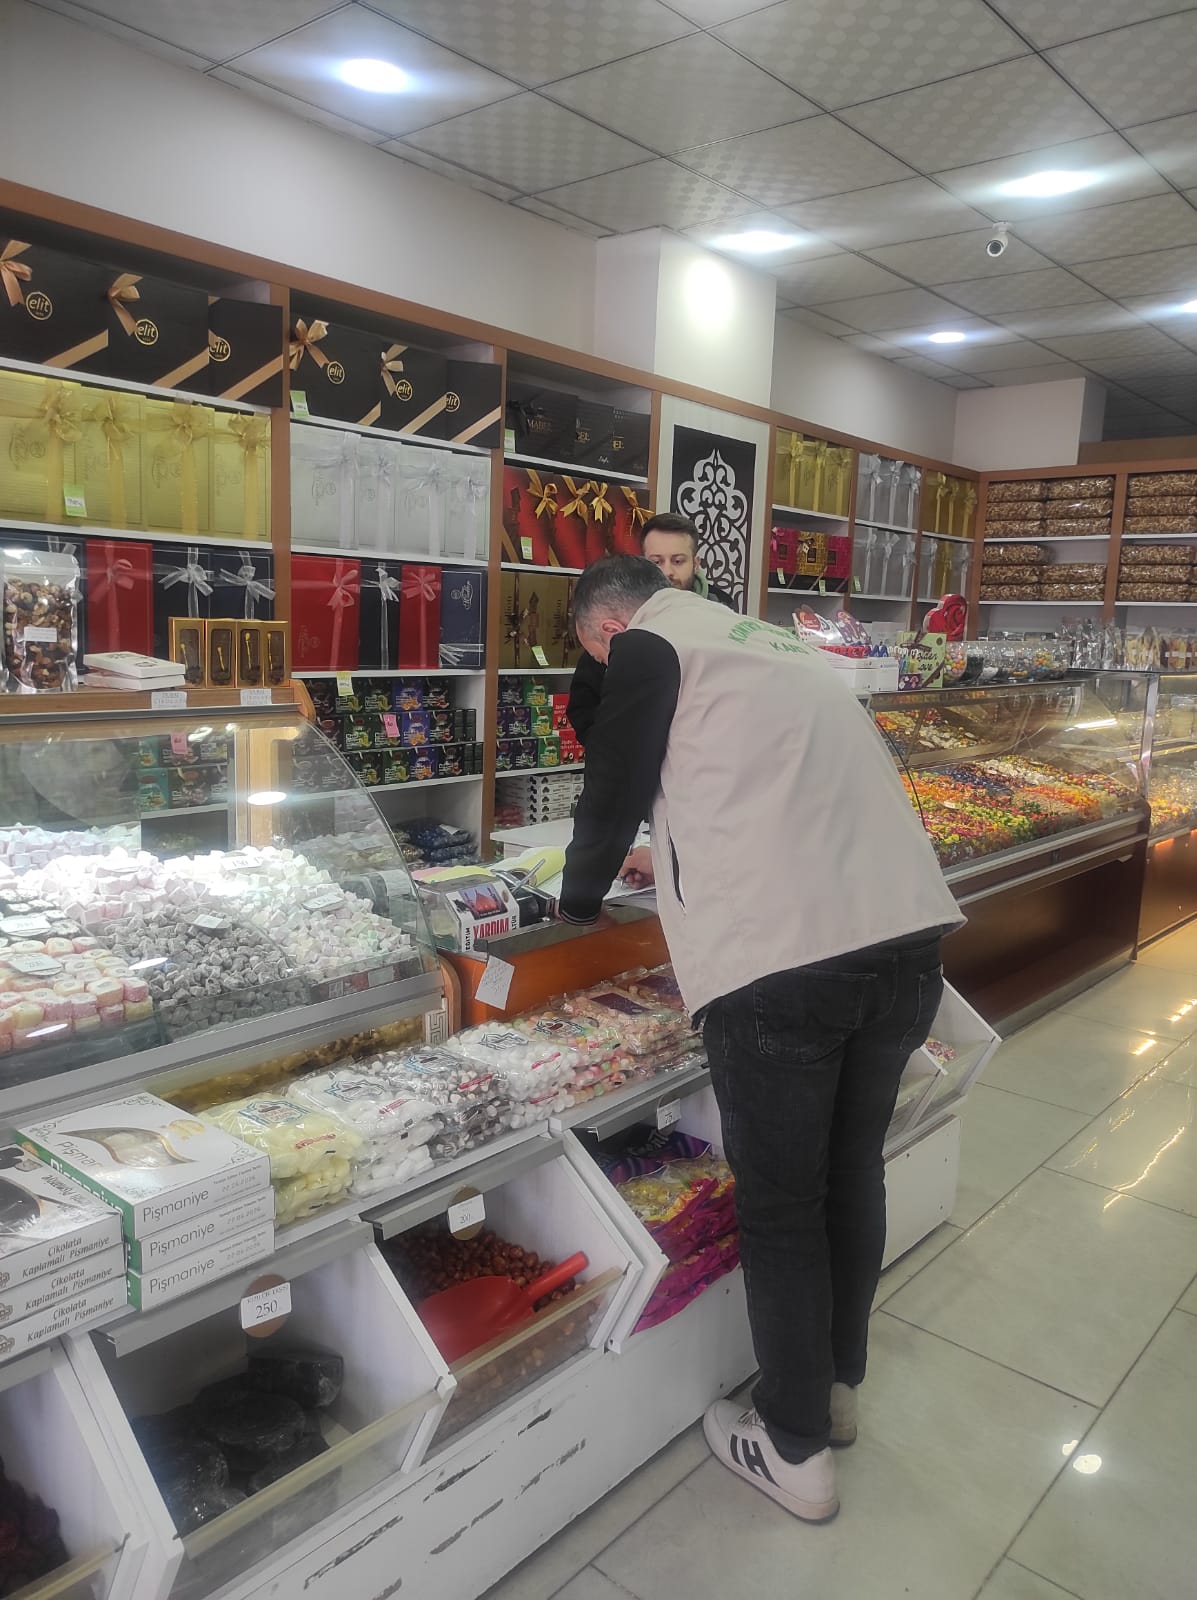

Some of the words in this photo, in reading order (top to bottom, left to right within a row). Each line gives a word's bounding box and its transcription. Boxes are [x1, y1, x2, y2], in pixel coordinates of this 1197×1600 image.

[29, 297, 50, 313] elit
[137, 324, 155, 338] elit
[329, 366, 343, 379] elit
[398, 384, 411, 396] elit
[473, 917, 509, 940] YARDIM
[142, 1189, 209, 1223] Pişmaniye
[48, 1237, 82, 1257] Çikolata
[149, 1222, 215, 1257] Pişmaniye
[22, 1255, 65, 1279] Kaplamalı
[69, 1237, 110, 1259] Pişmaniye
[51, 1268, 85, 1289] Çikolata
[149, 1258, 215, 1294] Pişmaniye
[25, 1287, 68, 1311] Kaplamalı
[72, 1267, 113, 1291] Pişmaniye
[27, 1317, 70, 1343] Kaplamalı
[74, 1297, 114, 1321] Pişmaniye
[53, 1298, 87, 1321] Çikolata
[255, 1299, 278, 1319] 250
